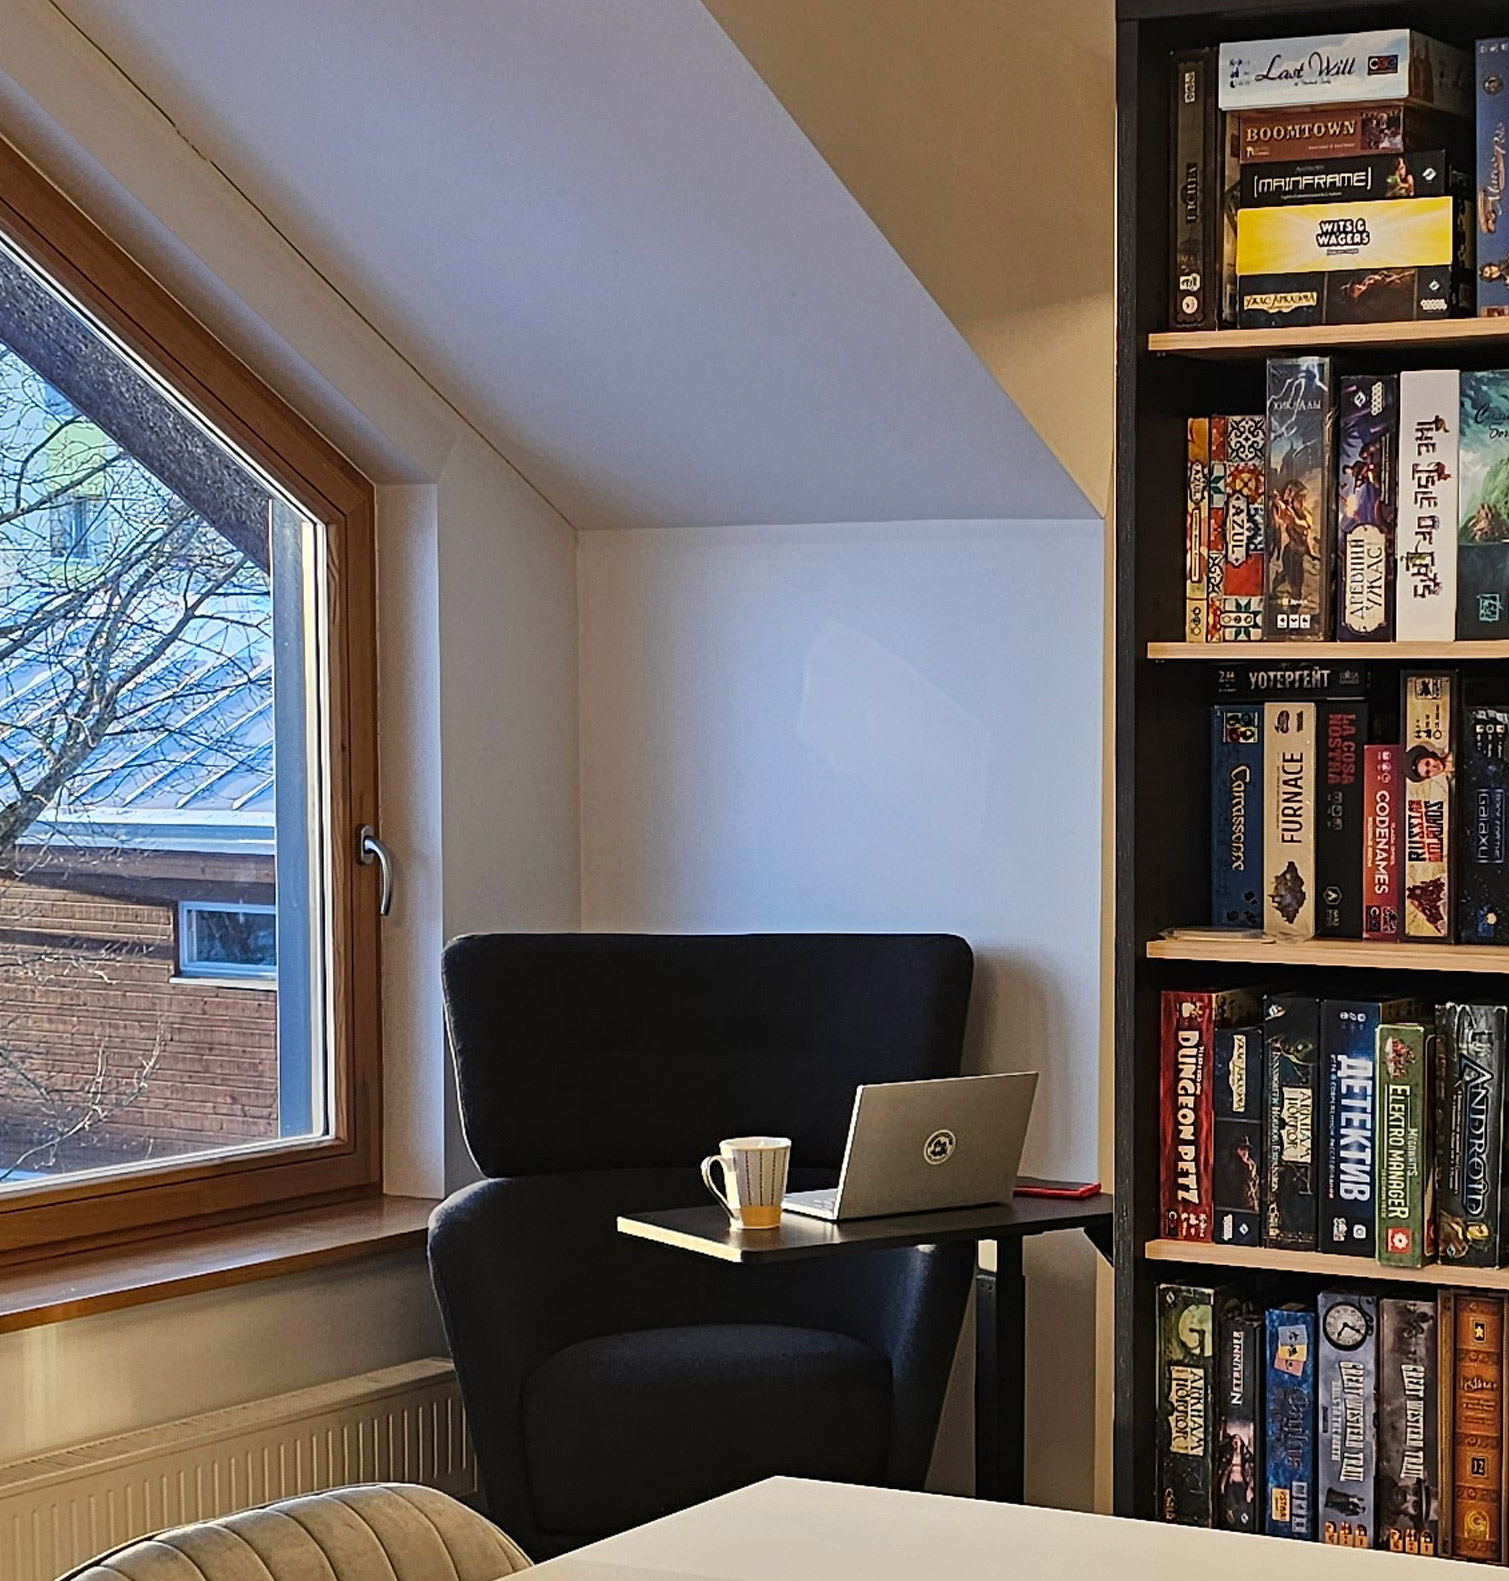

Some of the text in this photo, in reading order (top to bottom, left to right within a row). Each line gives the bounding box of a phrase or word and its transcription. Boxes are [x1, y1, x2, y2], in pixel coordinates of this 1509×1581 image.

[1255, 51, 1357, 82] Last Will
[1246, 120, 1357, 143] BOOMTOWN
[1317, 232, 1370, 246] WAGERS
[1319, 220, 1352, 233] WITS
[1231, 503, 1245, 555] AZUL
[1366, 547, 1383, 609] УЖАС
[1281, 751, 1304, 844] FURNACE
[1376, 789, 1390, 896] CODENAMES
[1177, 1030, 1200, 1205] DUNGEON PETZ
[1337, 1054, 1374, 1201] ДЕТЕКТИВ
[1388, 1083, 1411, 1220] ELEKTRO MANAGER
[1461, 1053, 1494, 1216] ANDROID
[1231, 1330, 1244, 1406] NETRUNNER
[1401, 1364, 1425, 1398] GREAT
[1189, 1369, 1205, 1456] ARKHAM
[1339, 1361, 1364, 1483] GREAT WESTERN TRAIL
[1406, 1399, 1425, 1449] WESTERN
